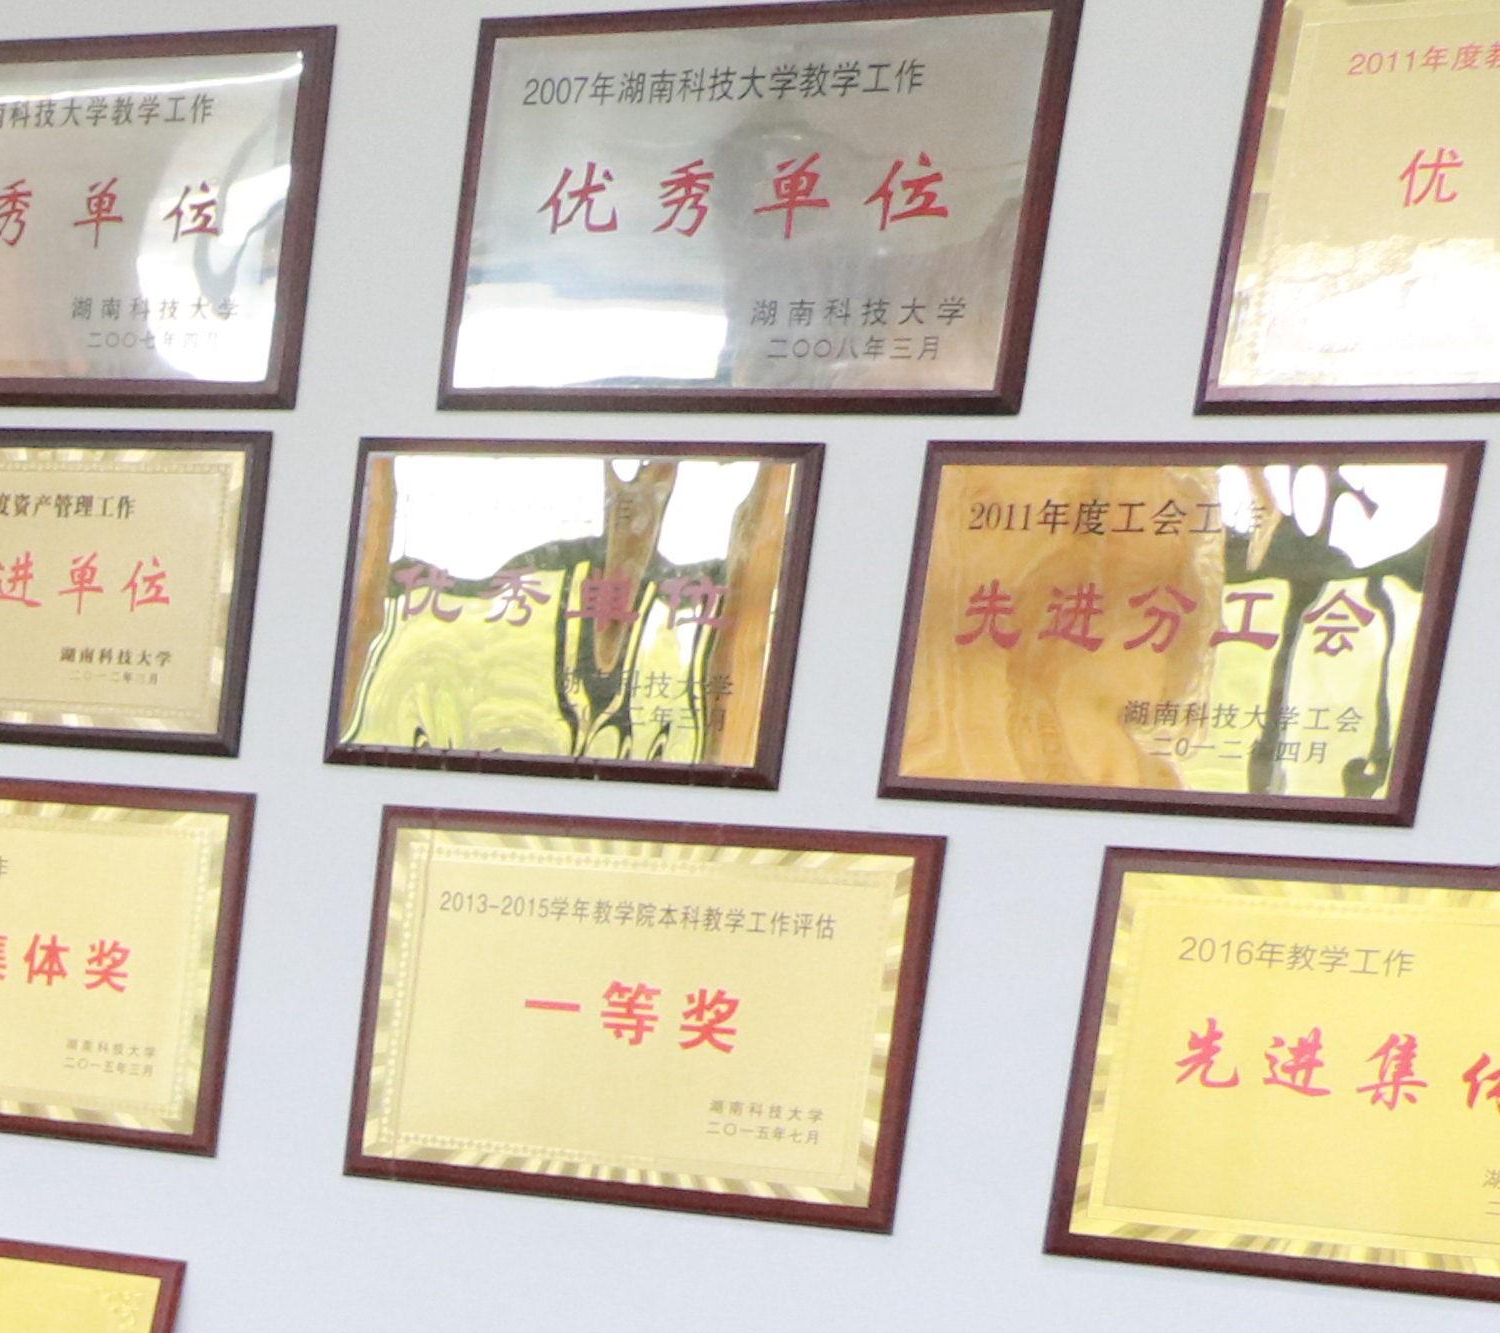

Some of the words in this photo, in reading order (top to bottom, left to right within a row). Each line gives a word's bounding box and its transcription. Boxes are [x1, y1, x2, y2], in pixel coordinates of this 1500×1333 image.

[523, 58, 926, 106] 2007年湖南科技大学教学工作
[538, 151, 948, 239] 优秀单位
[1399, 147, 1464, 208] 优
[71, 296, 239, 322] 湖南科技大学
[751, 297, 966, 327] 湖南科技大学
[392, 564, 736, 632] 优秀单位
[956, 578, 1376, 656] 先进分工会
[60, 646, 172, 668] 湖南科技大学
[1124, 699, 1364, 733] 湖南科技大学工会
[439, 890, 837, 941] 2013-2015学年教学院本科教学工作评估
[1179, 936, 1417, 978] 2016年教学工作
[525, 980, 741, 1054] 一等奖
[709, 1099, 824, 1124] 湖南科技大学
